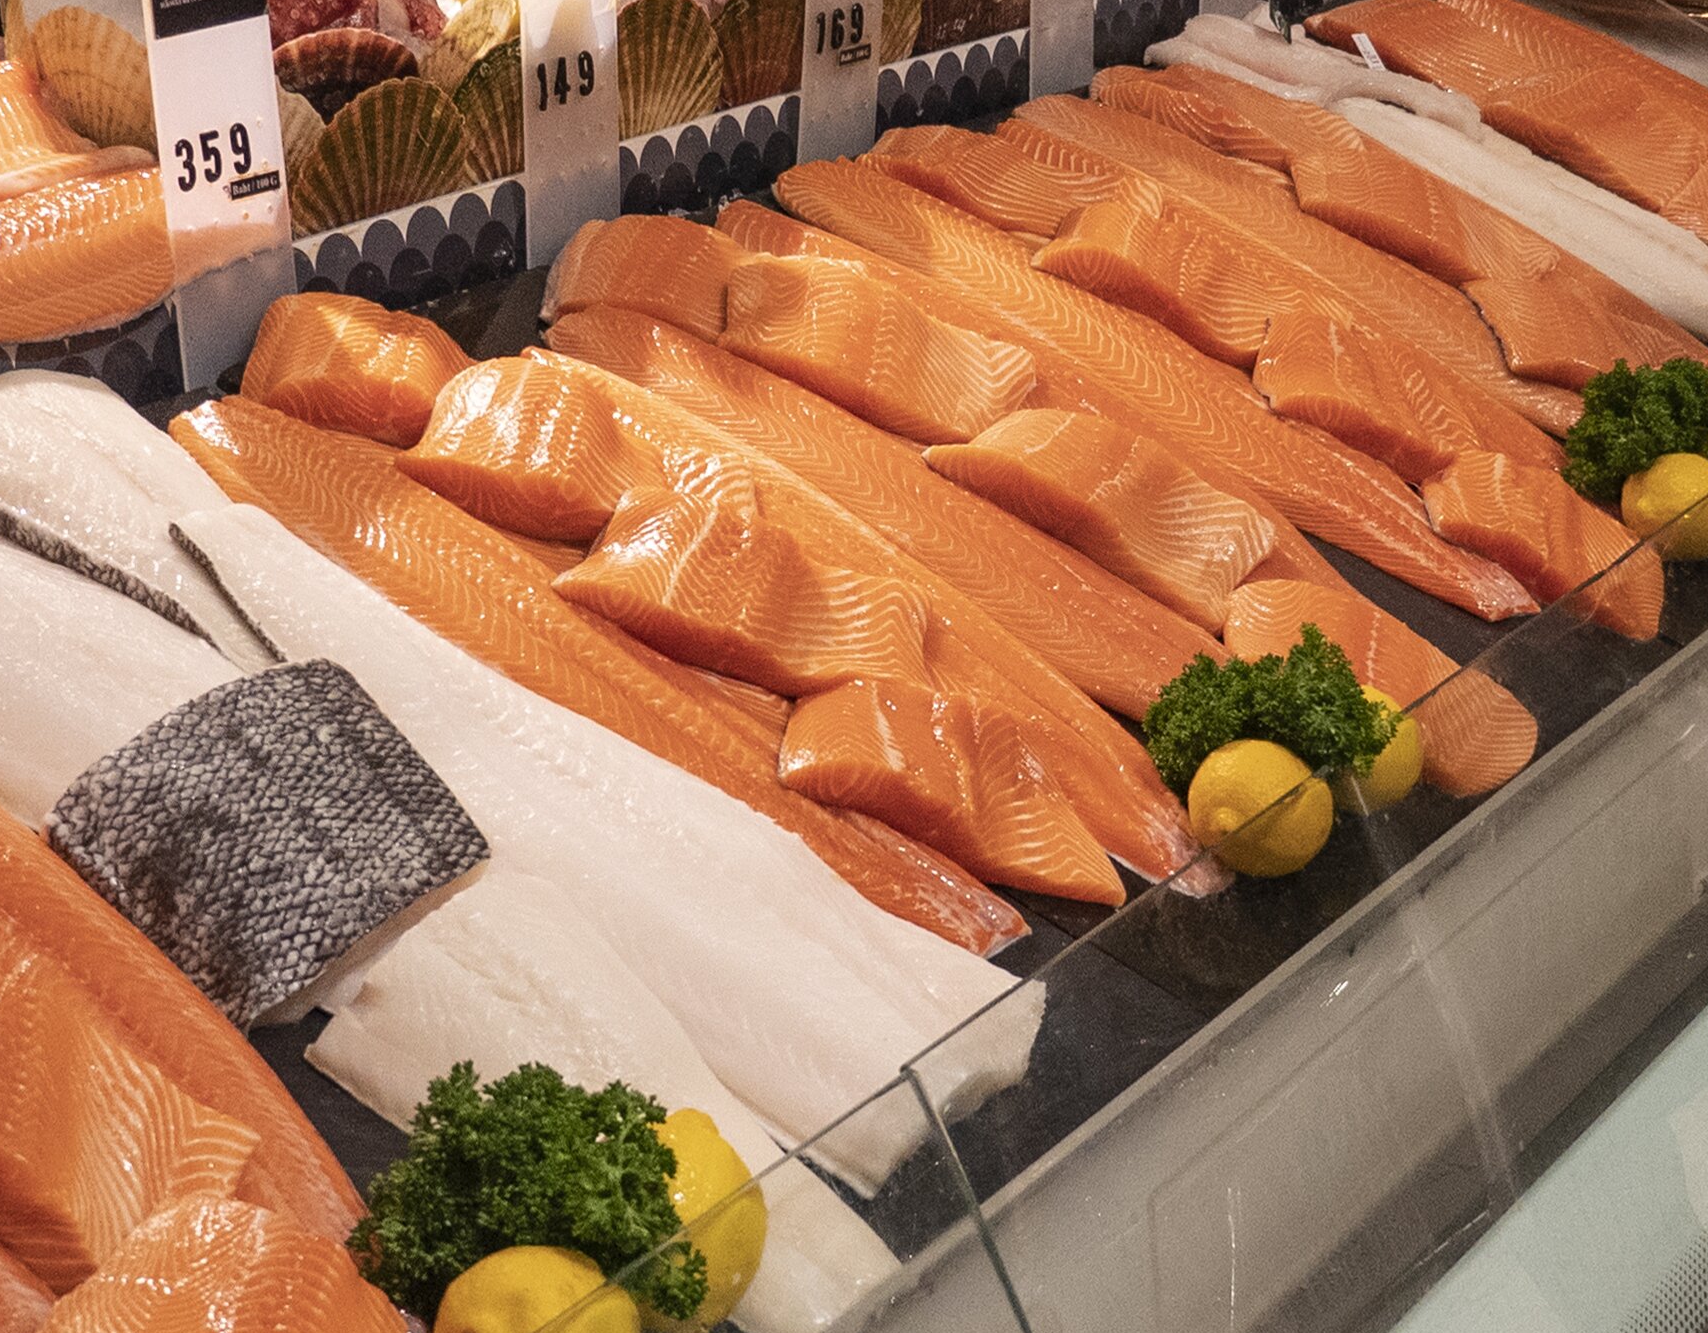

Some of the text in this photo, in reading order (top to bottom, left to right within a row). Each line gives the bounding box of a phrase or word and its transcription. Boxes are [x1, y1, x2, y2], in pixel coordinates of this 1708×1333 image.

[816, 3, 864, 55] 169
[537, 50, 594, 111] 149
[175, 122, 252, 192] 359
